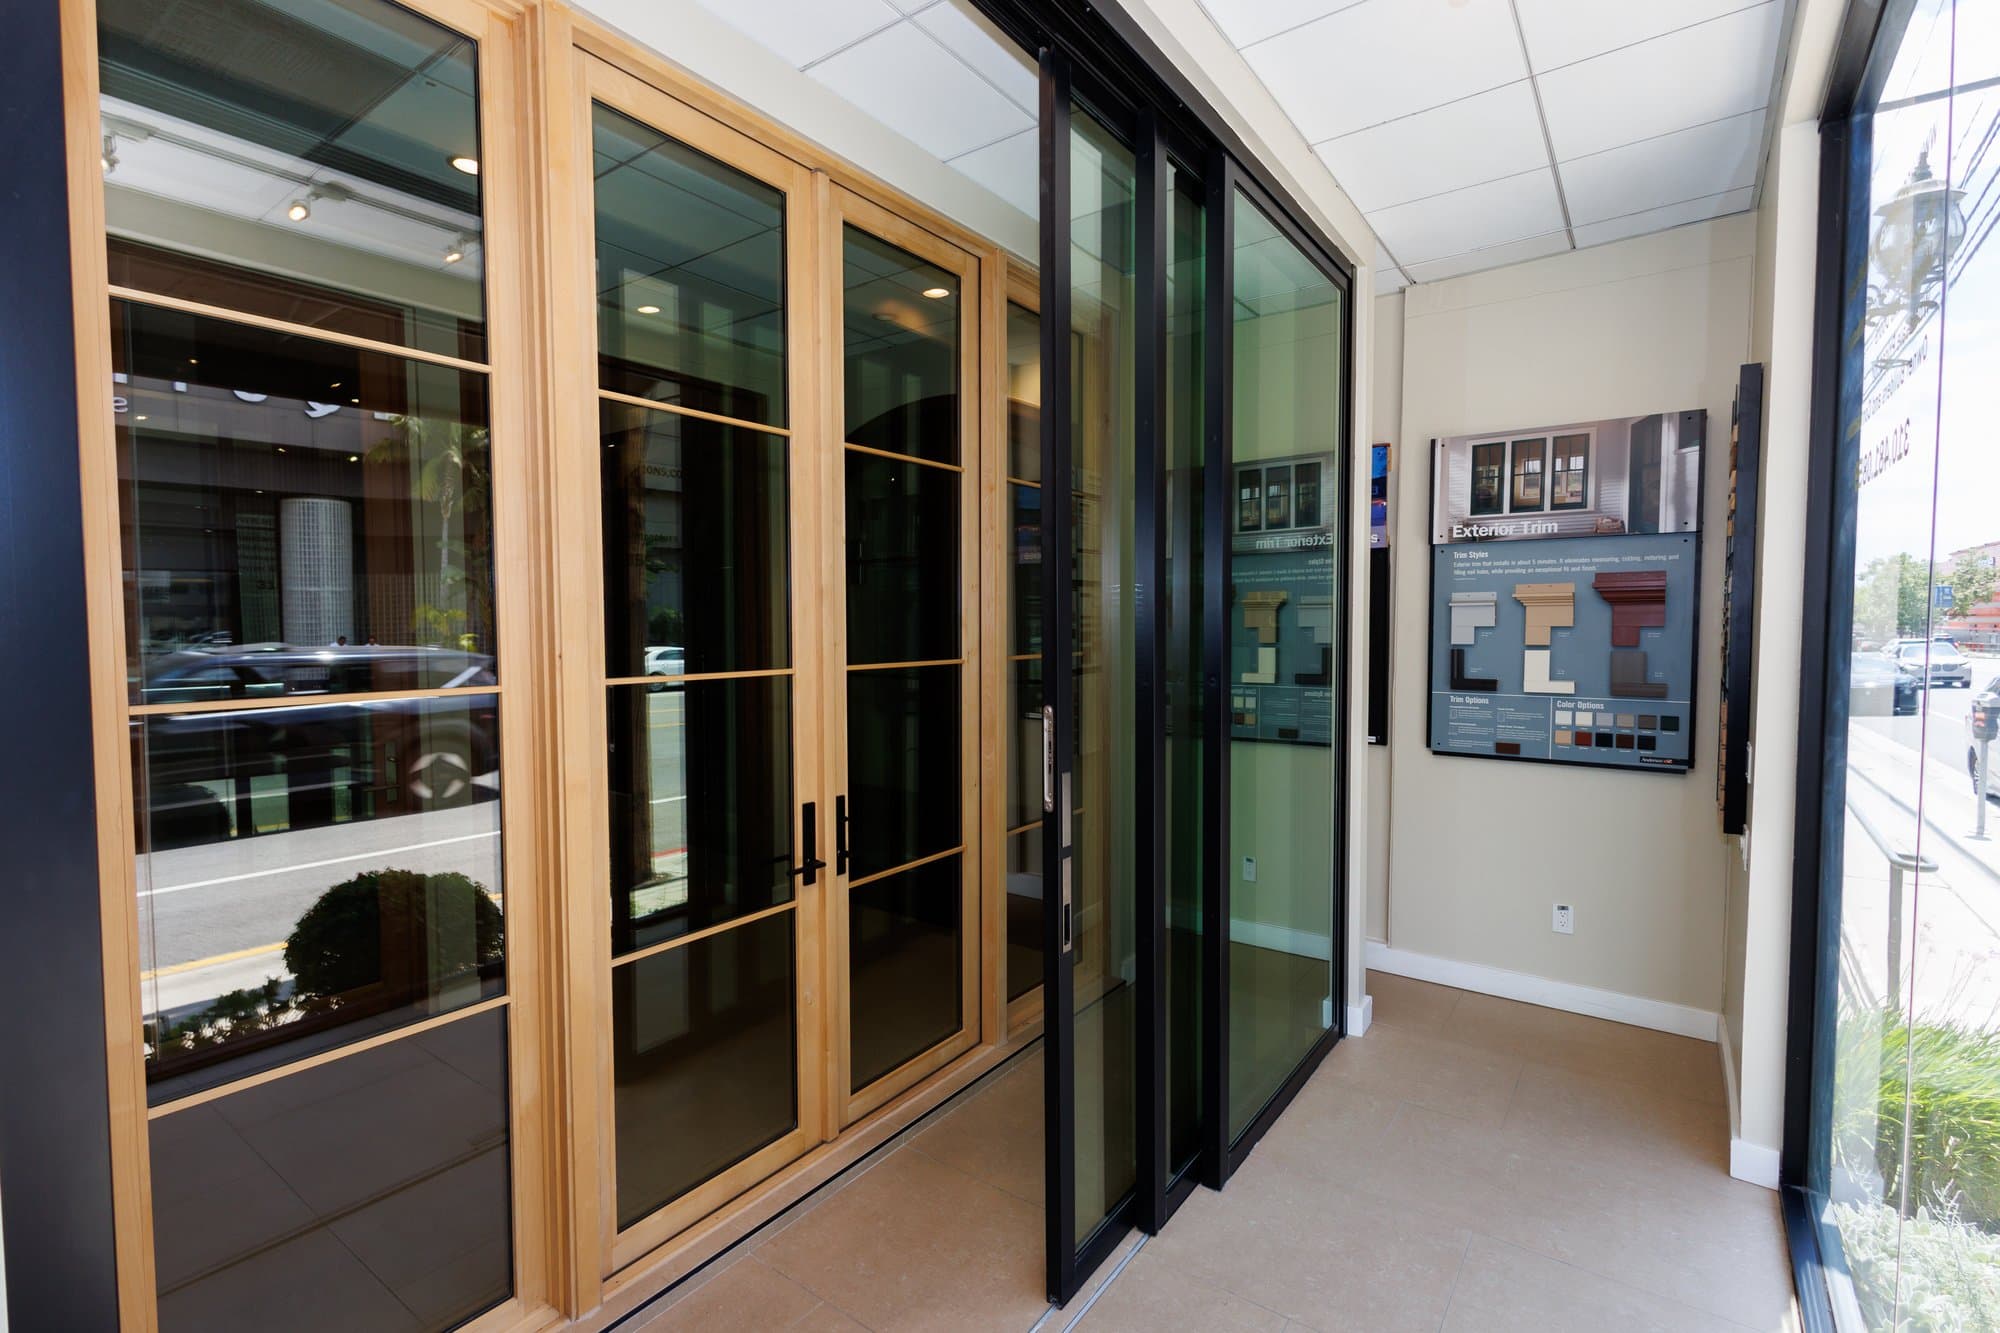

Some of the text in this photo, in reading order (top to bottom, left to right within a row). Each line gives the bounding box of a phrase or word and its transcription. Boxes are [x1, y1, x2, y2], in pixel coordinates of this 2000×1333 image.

[1452, 520, 1558, 538] Exterior Trim
[1453, 551, 1488, 560] Trim Styles
[1449, 695, 1489, 705] Trim Options
[1556, 700, 1605, 710] Color Options
